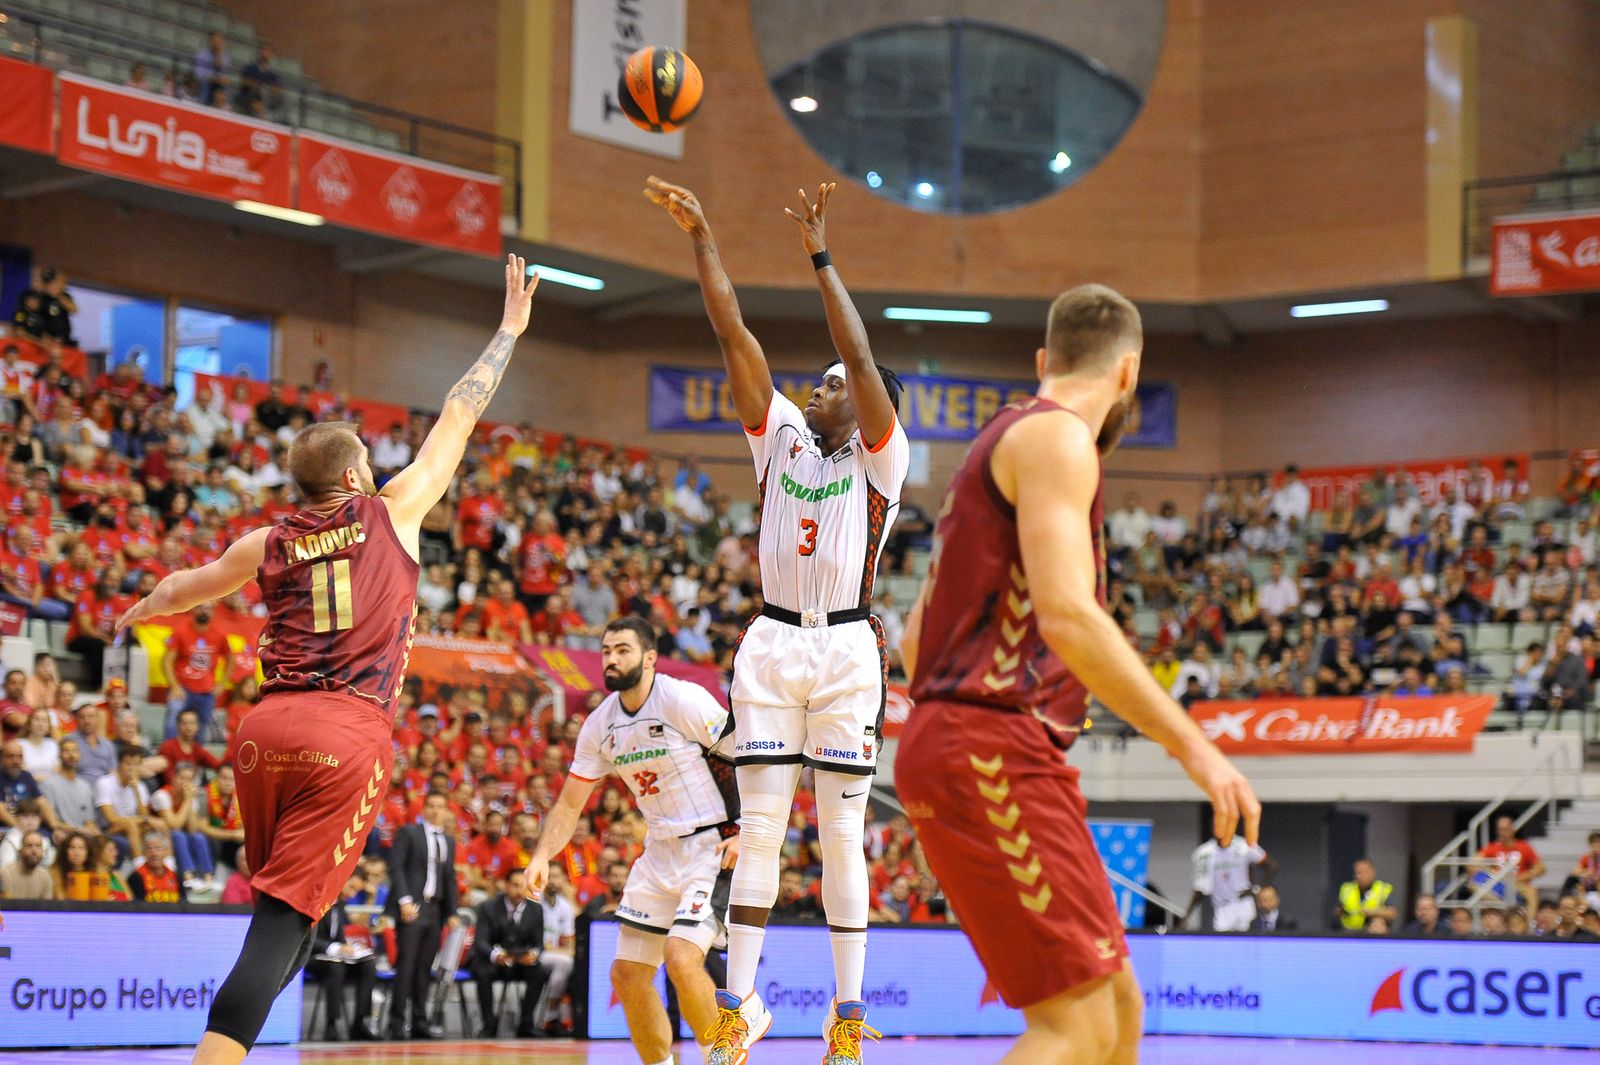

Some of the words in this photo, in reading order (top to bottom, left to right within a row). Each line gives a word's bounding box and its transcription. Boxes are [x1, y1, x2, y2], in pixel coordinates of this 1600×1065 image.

[284, 521, 366, 565] RADOVIC
[798, 518, 819, 556] 3
[312, 559, 353, 633] 11
[264, 750, 297, 762] Costa
[299, 750, 340, 768] Cálida
[823, 748, 858, 760] BERNER
[633, 770, 660, 797] 32
[12, 978, 107, 1019] Grupo
[118, 978, 215, 1008] Helveti
[766, 981, 825, 1014] Grupo
[1411, 969, 1583, 1017] caser
